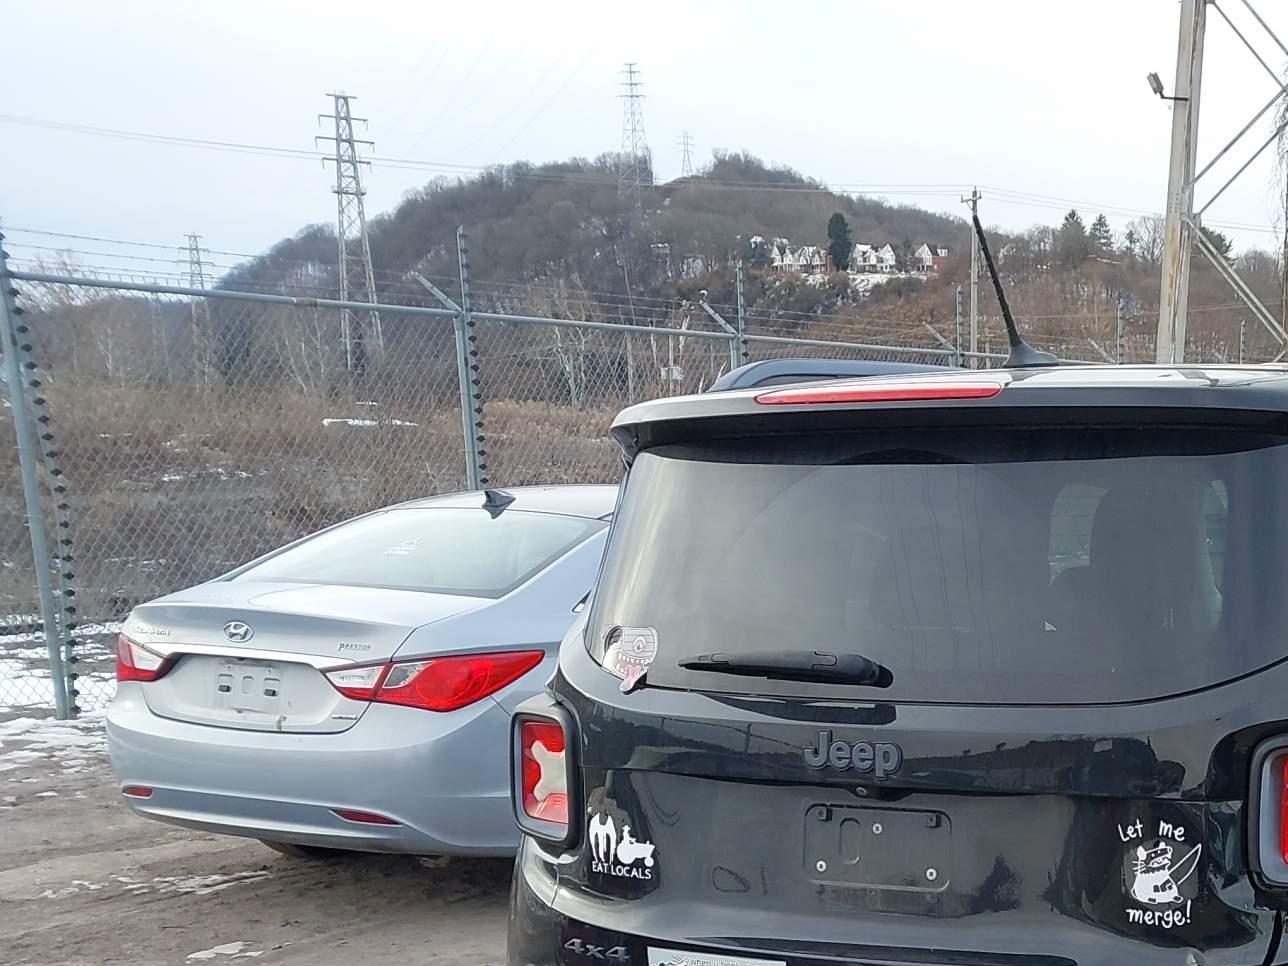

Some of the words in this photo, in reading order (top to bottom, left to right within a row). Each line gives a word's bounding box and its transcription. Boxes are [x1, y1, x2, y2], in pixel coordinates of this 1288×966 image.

[802, 729, 902, 779] Jeep
[1118, 819, 1144, 842] Let
[1159, 820, 1185, 842] me
[592, 860, 609, 874] EAT
[610, 864, 652, 880] LOCALS
[1126, 899, 1192, 929] merge!
